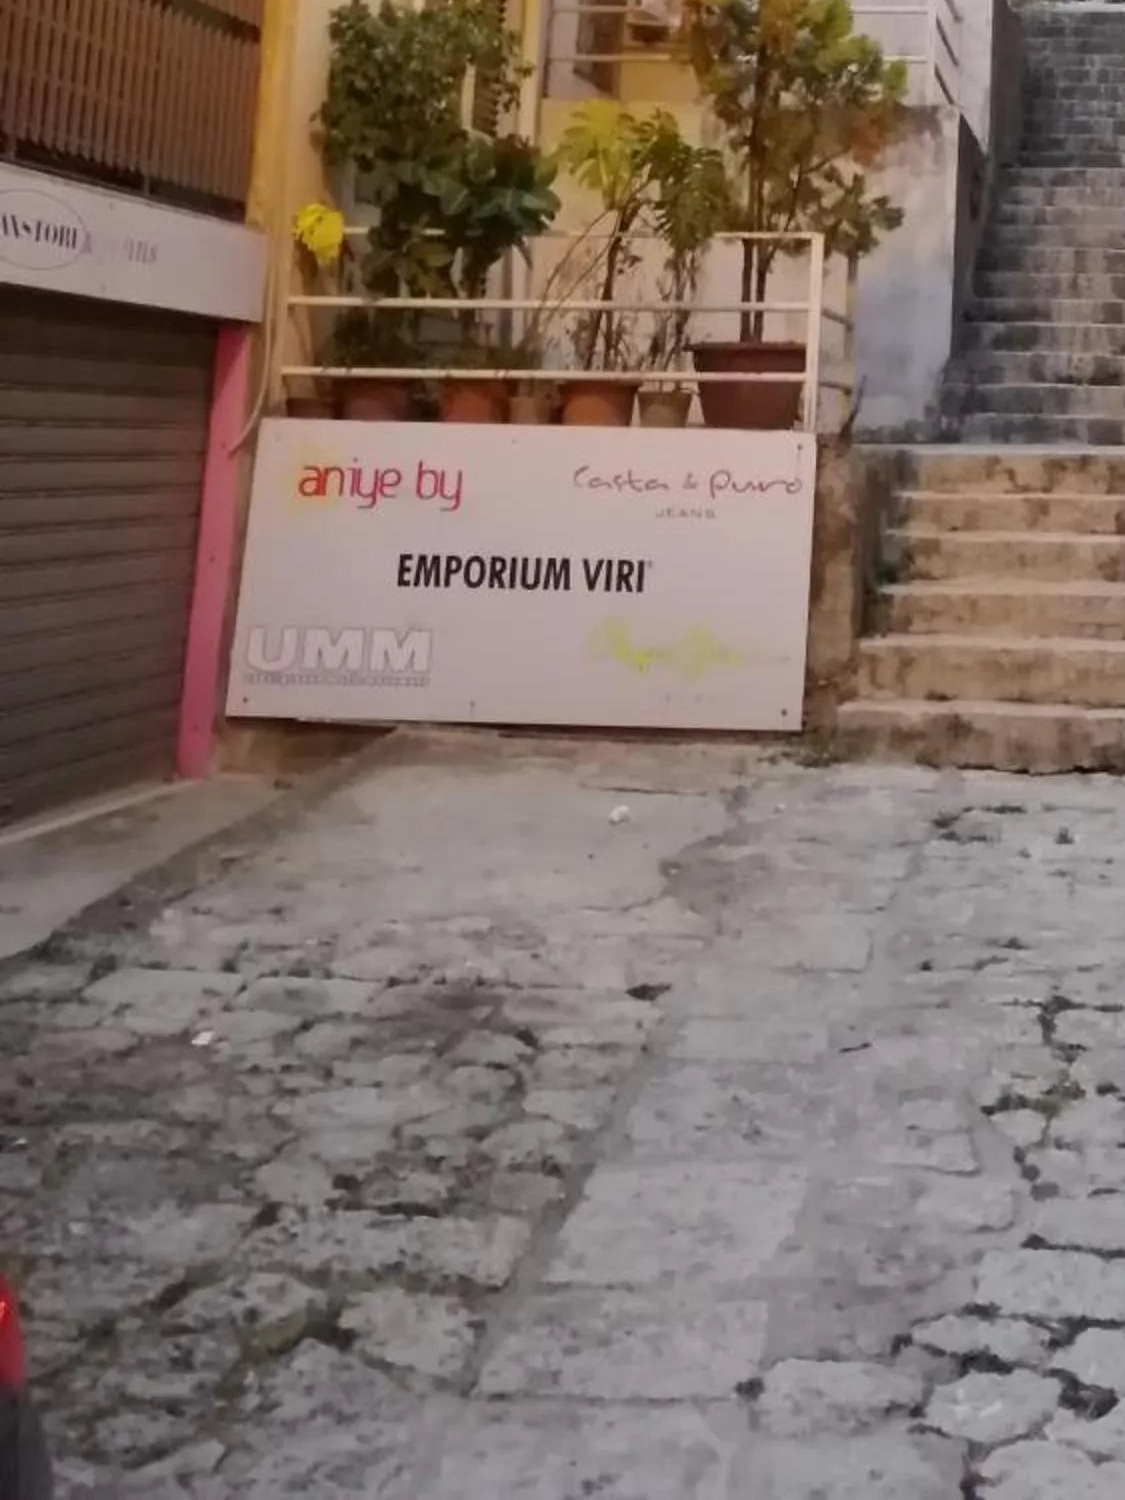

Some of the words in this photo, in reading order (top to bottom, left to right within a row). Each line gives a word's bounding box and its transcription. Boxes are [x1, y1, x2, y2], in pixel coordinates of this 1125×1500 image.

[298, 456, 402, 510] aniye
[416, 459, 463, 511] by
[397, 553, 572, 591] EMPORIUM
[582, 558, 646, 593] VIRI
[247, 626, 433, 673] UMM
